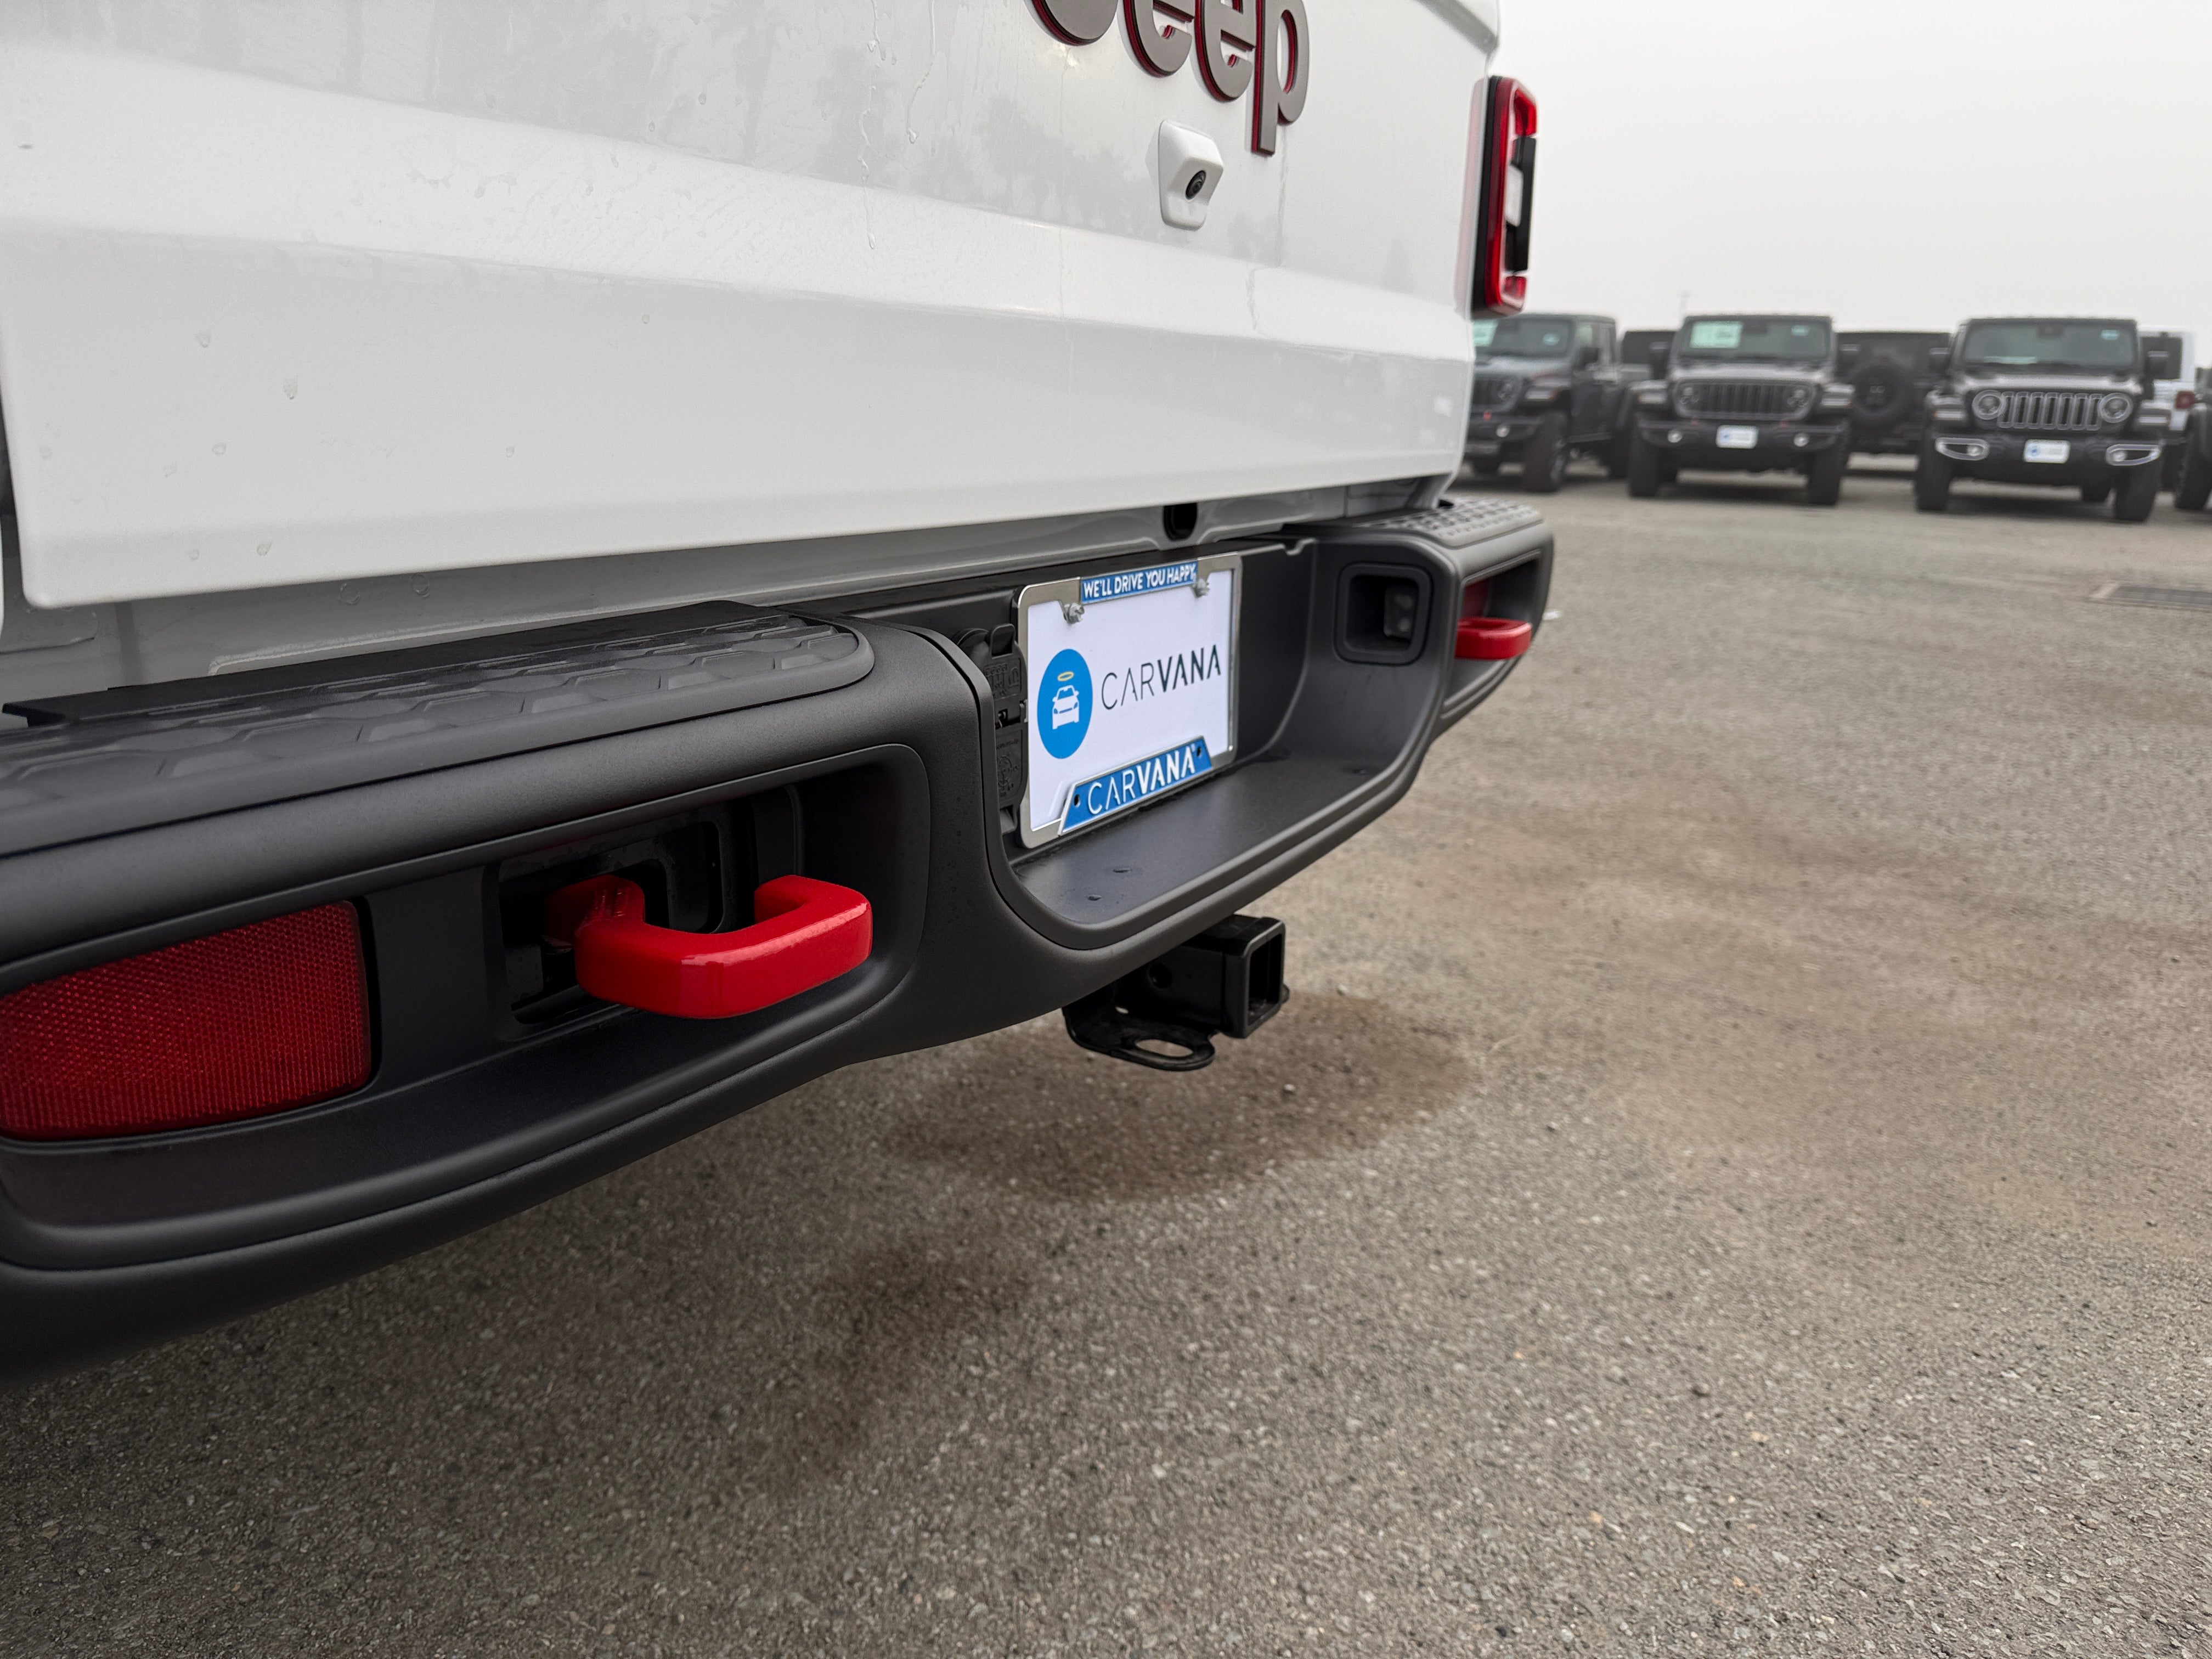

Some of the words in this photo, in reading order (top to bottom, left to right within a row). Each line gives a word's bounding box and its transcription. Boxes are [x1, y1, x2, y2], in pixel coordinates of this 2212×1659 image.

[1032, 0, 1310, 155] eep
[1084, 578, 1113, 599] WE'LL
[1114, 572, 1143, 594] DRIVE
[1145, 568, 1165, 588] YOU
[1101, 644, 1221, 710] CARVANA
